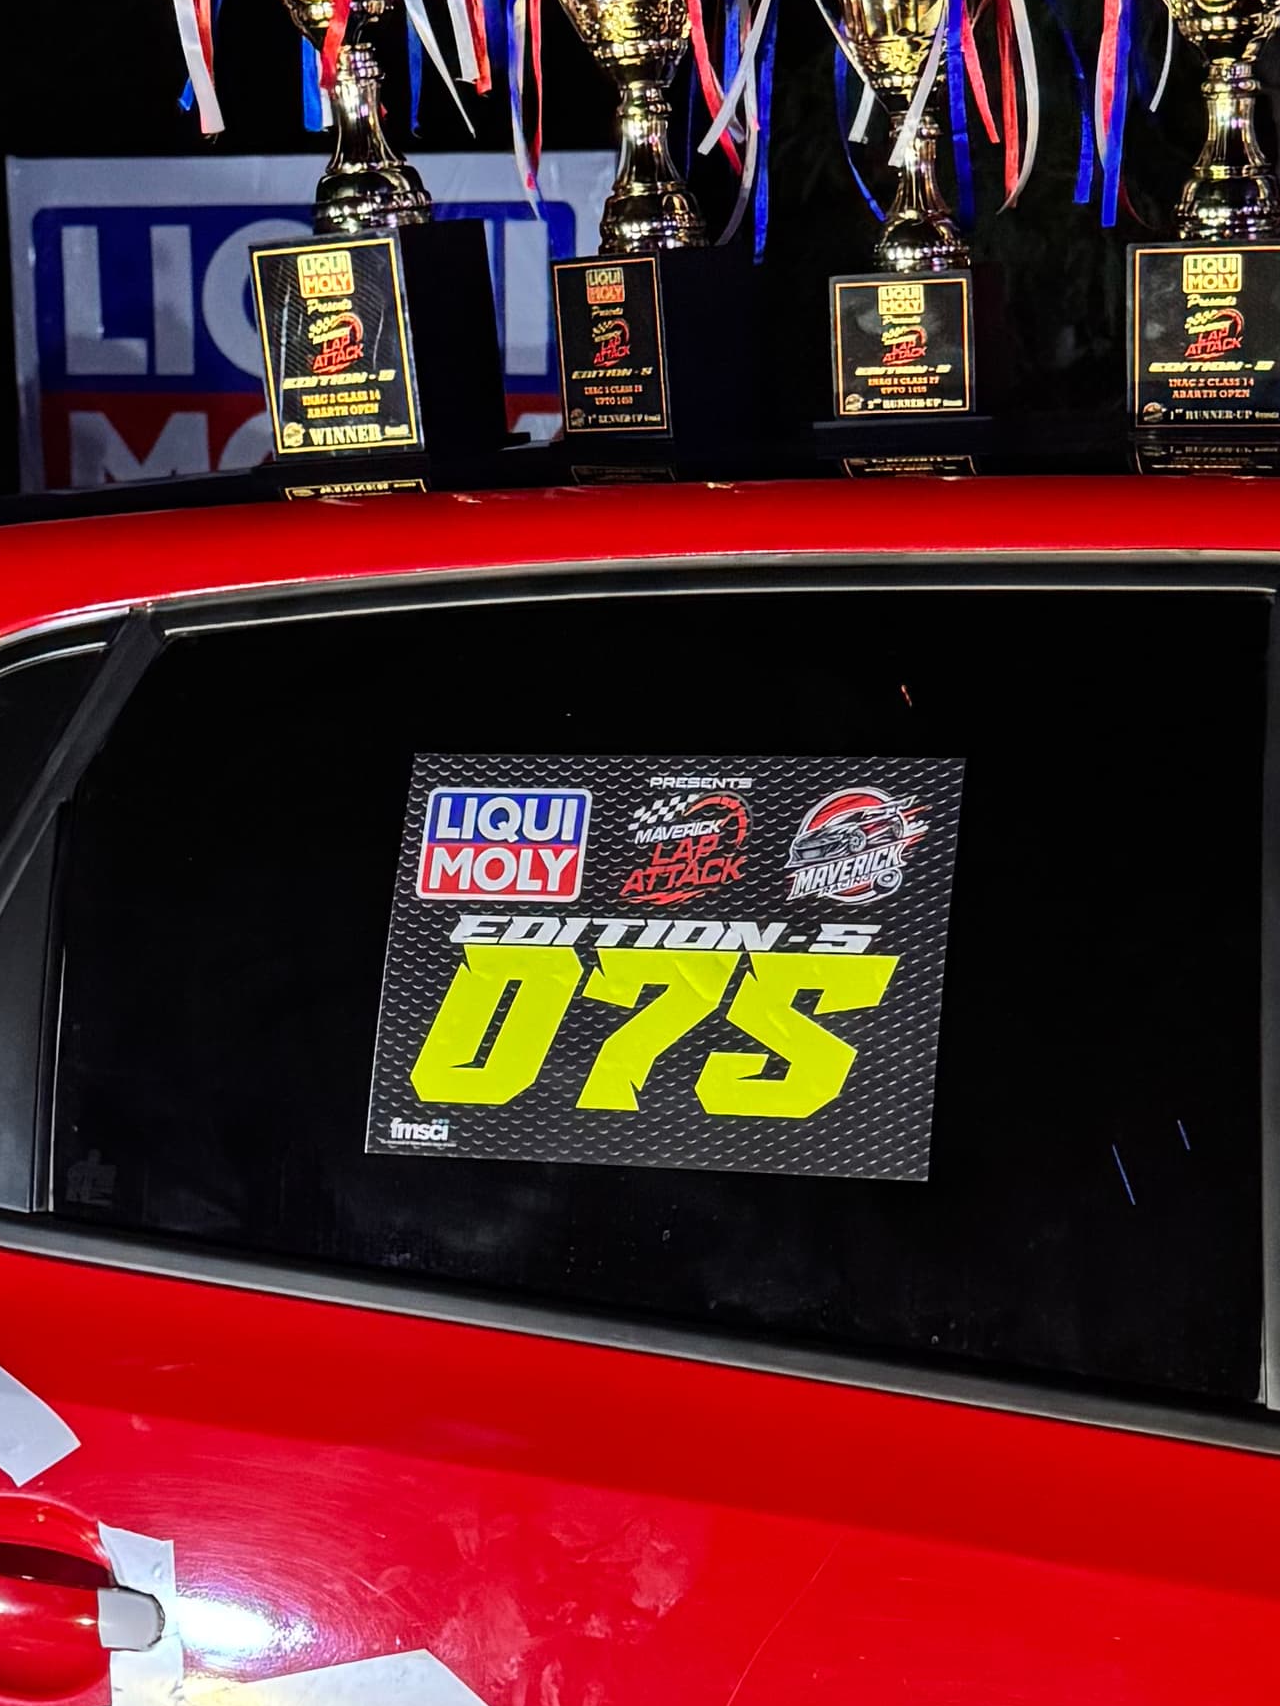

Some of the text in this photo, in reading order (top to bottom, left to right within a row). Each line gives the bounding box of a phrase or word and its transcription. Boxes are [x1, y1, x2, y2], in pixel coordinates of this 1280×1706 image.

[301, 255, 349, 275] LIQUI
[1187, 257, 1238, 274] LIQUI
[303, 275, 352, 294] MOLY
[588, 270, 622, 287] LIQUI
[1187, 274, 1238, 290] MOLY
[60, 219, 549, 376] LII
[322, 334, 351, 354] LAP
[1197, 325, 1231, 343] LAP
[312, 343, 364, 370] ATTACK
[1184, 336, 1244, 357] ATTACK
[1218, 388, 1251, 399] OPEN
[309, 424, 383, 446] WINNER
[650, 777, 752, 789] PRESENTS
[436, 796, 578, 843] LIQUI
[635, 820, 724, 843] MAVERICK
[652, 834, 720, 866] LAP
[428, 847, 578, 892] MOLY
[619, 856, 748, 896] ATTACK
[793, 844, 900, 895] MAVERICK
[390, 1117, 450, 1141] fmsci
